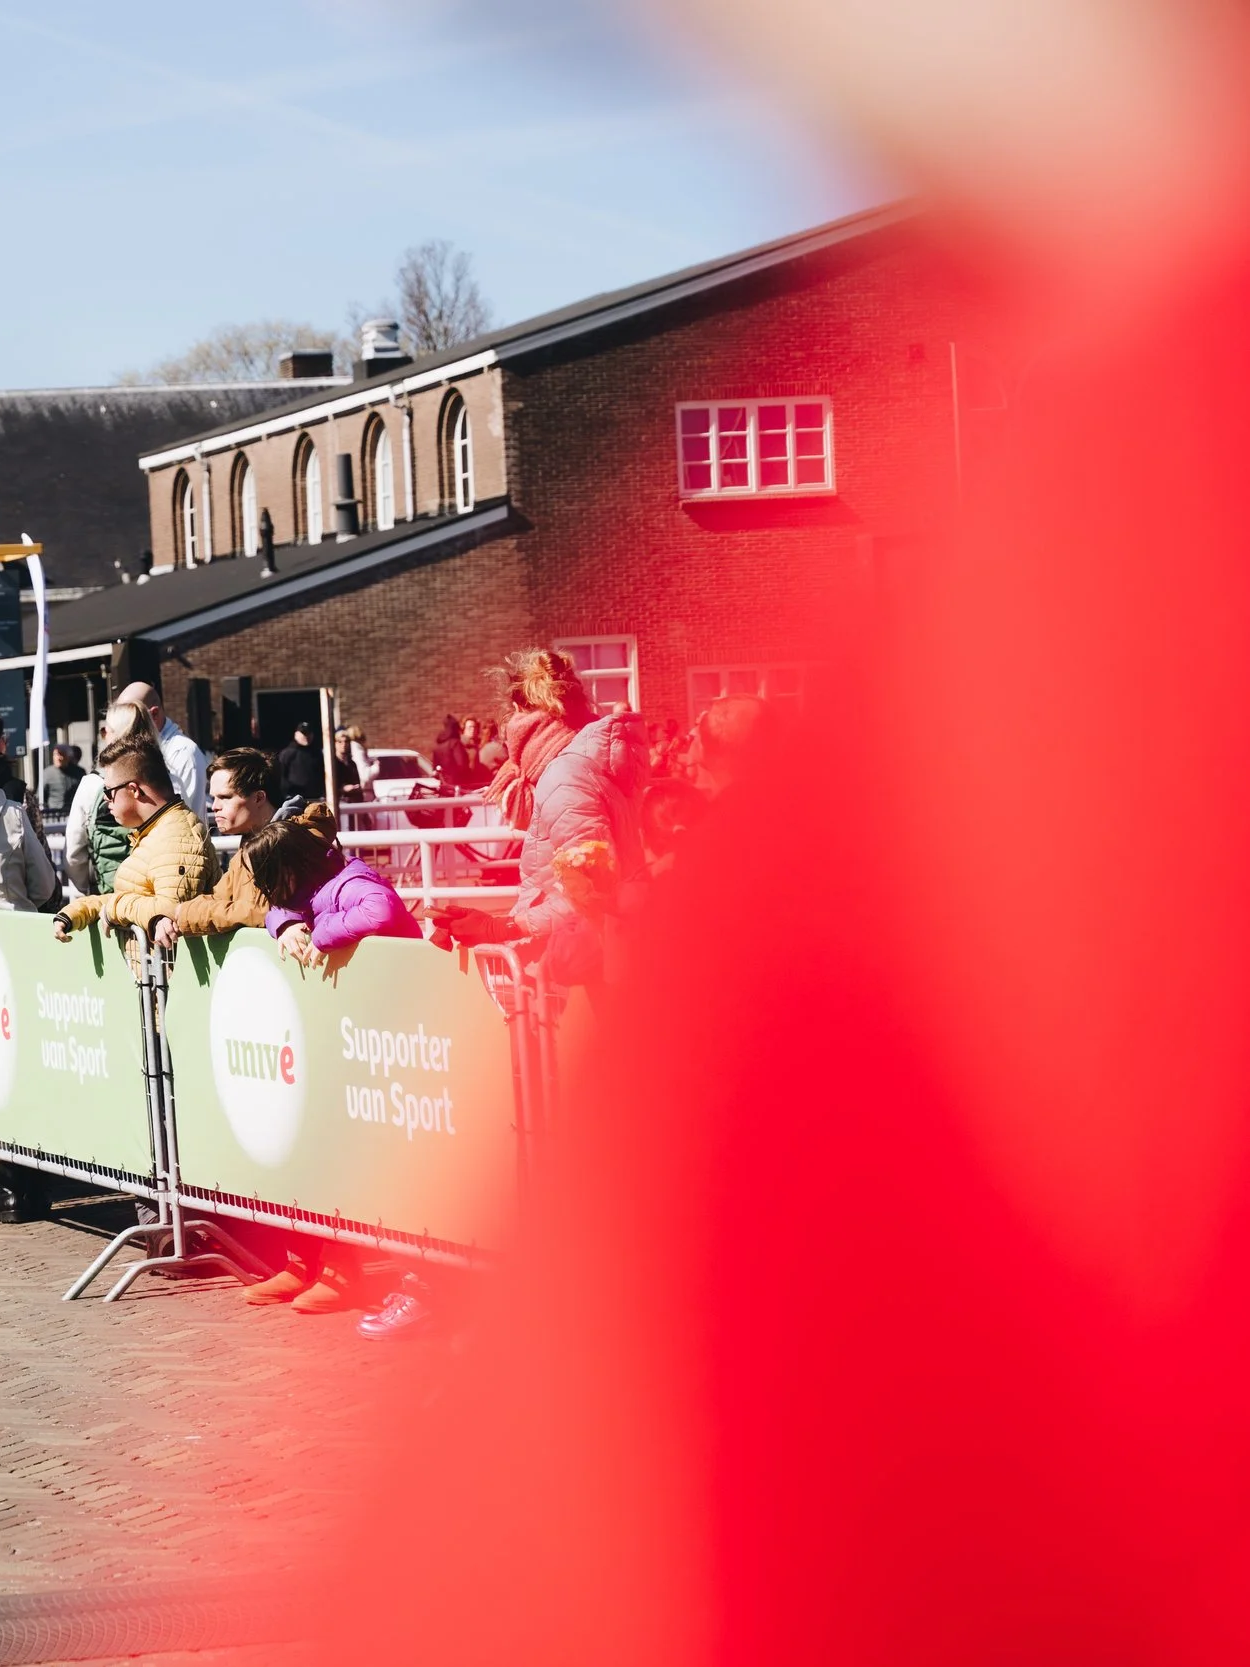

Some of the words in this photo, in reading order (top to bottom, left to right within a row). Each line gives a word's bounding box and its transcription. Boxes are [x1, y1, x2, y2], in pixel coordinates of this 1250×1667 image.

[37, 983, 106, 1032] Supporter
[42, 1040, 66, 1070] van
[68, 1036, 109, 1084] Sport
[226, 1030, 295, 1084] univé
[341, 1017, 451, 1077] Supporter
[346, 1085, 386, 1122] van
[390, 1083, 455, 1140] Sport
